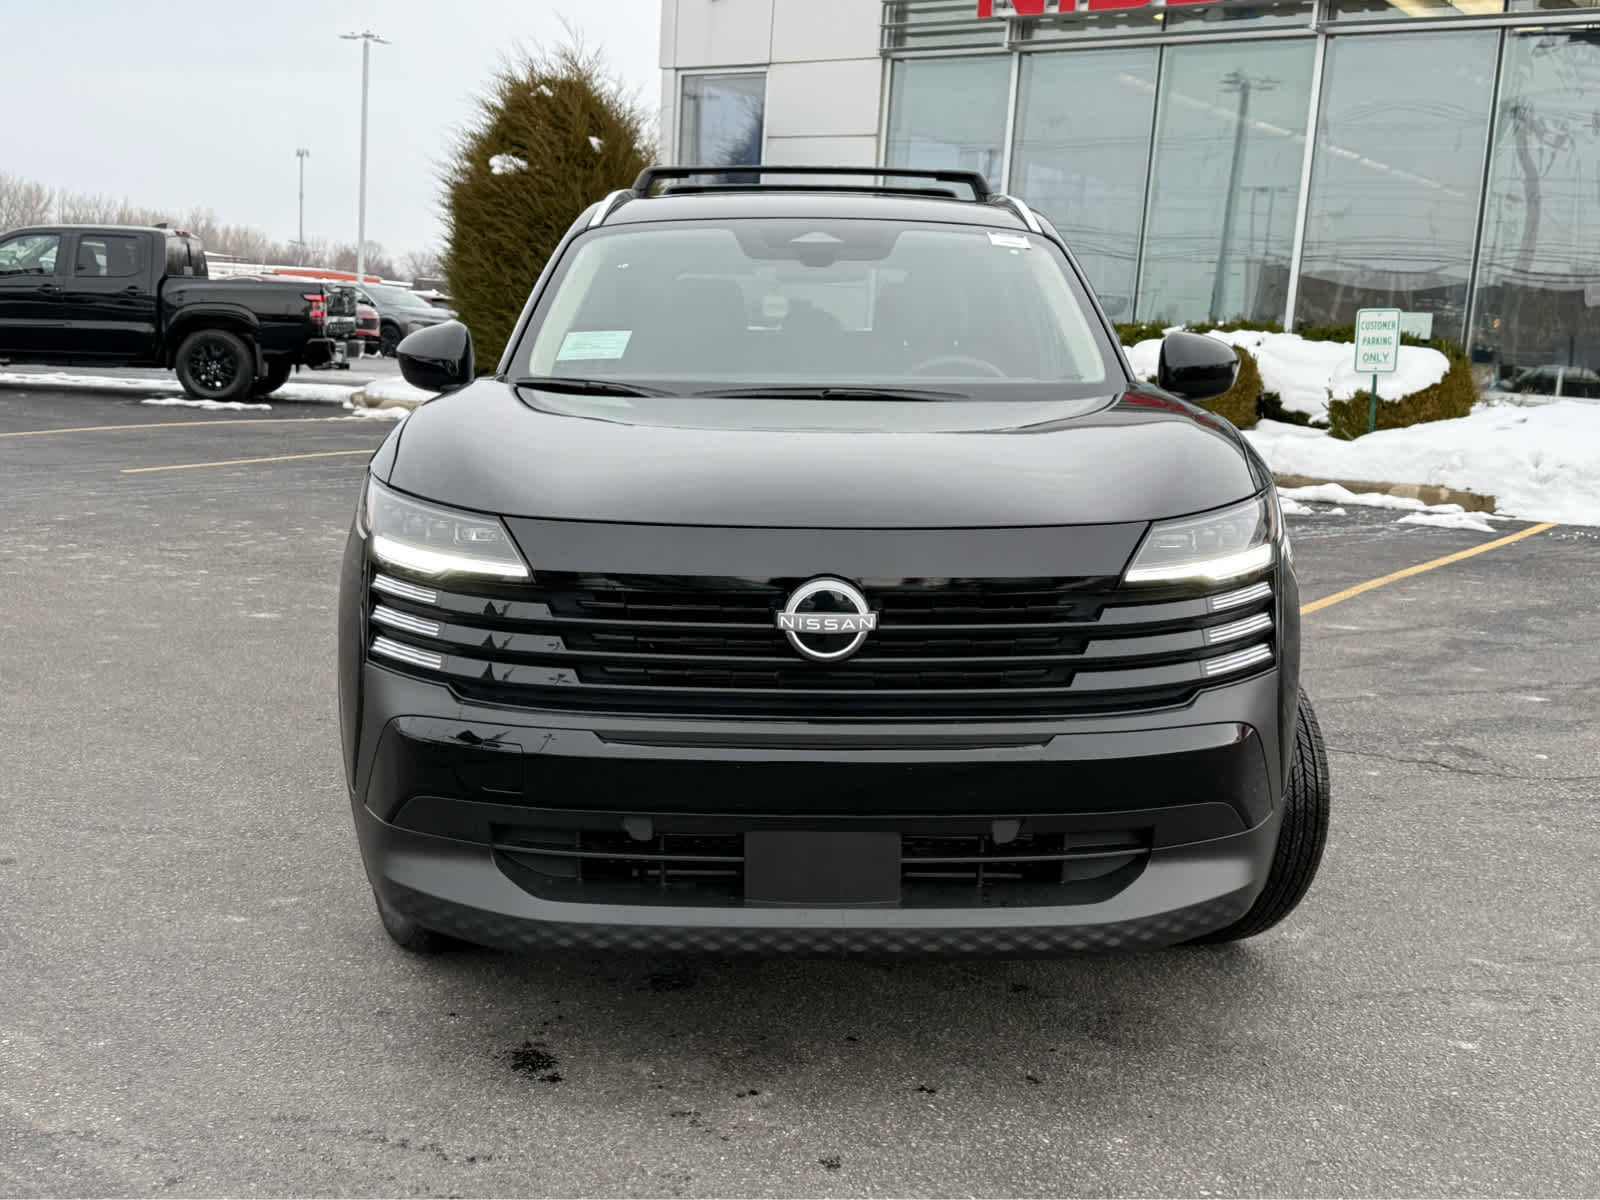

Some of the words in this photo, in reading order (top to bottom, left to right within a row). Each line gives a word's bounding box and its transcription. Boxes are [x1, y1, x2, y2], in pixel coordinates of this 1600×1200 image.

[1361, 320, 1396, 330] CUSTOMER
[1363, 336, 1392, 346] PARKING
[1363, 352, 1389, 362] ONLY
[780, 616, 874, 630] NISSAN
